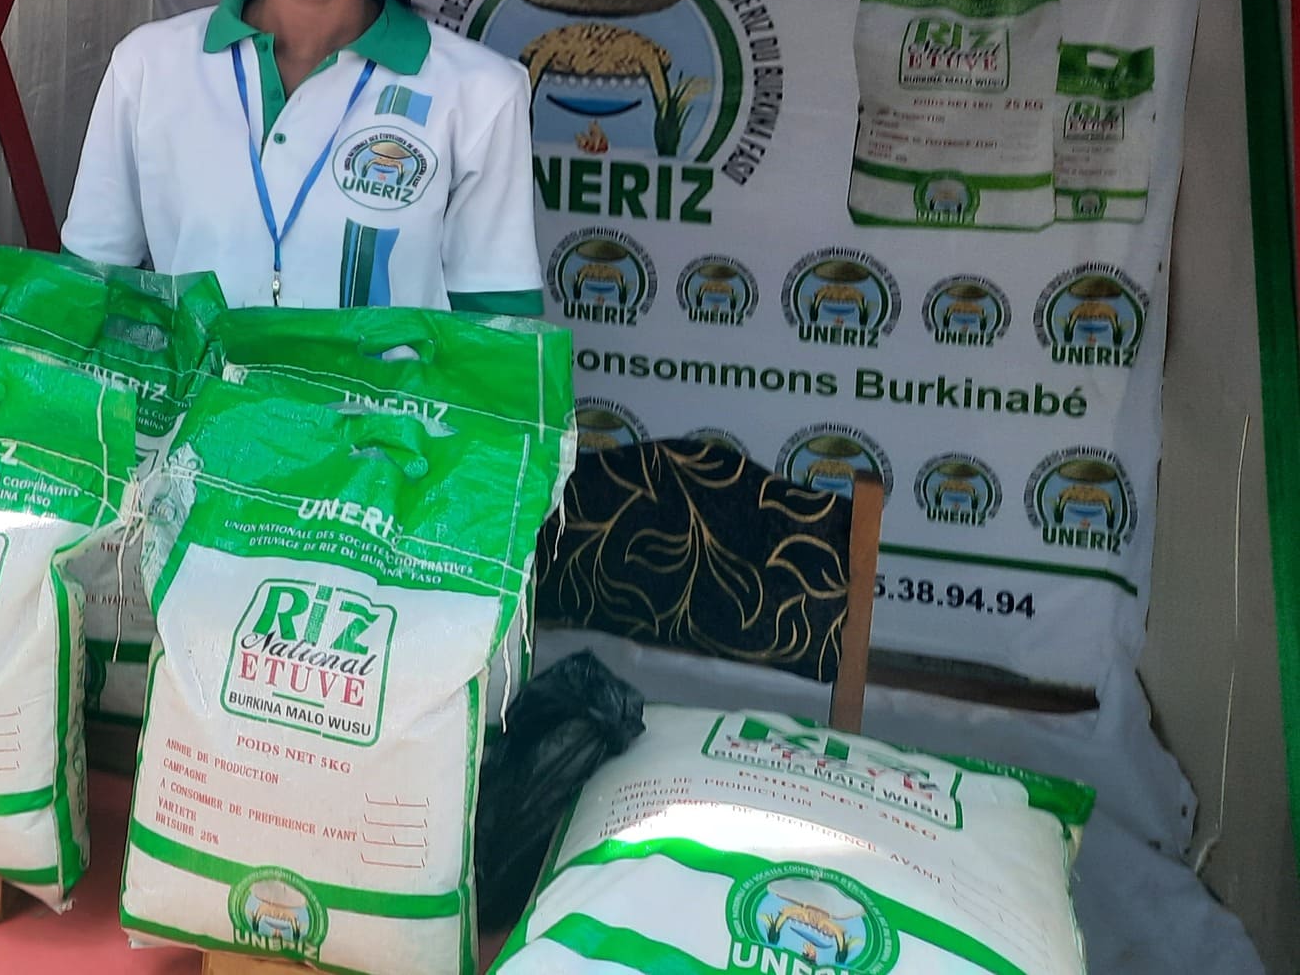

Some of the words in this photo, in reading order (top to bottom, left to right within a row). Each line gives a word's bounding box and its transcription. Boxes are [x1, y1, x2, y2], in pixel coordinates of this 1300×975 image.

[342, 177, 414, 205] UNERIZ
[534, 155, 713, 224] NERIZ
[562, 303, 638, 324] UNERIZ
[688, 309, 744, 325] UNERIZ
[798, 326, 878, 348] UNERIZ
[934, 329, 994, 347] UNERIZ
[1051, 345, 1136, 367] UNERIZ
[573, 349, 838, 397] onsommons
[855, 369, 1088, 418] Burkinabé
[224, 519, 257, 534] UNION
[258, 523, 313, 540] NATIONALE
[316, 530, 335, 541] DES
[926, 508, 986, 527] UNERIZ
[250, 535, 300, 550] D'ÉTUVAGE
[318, 542, 337, 553] RIZ
[340, 546, 357, 559] DU
[1042, 526, 1122, 555] UNERIZ
[251, 584, 380, 655] Riz
[240, 631, 379, 676] National
[238, 653, 366, 707] ETUVE
[229, 691, 282, 715] BURKINA
[286, 705, 324, 726] MALO
[328, 715, 372, 738] WUSU
[197, 751, 209, 763] DE
[214, 758, 279, 784] PRODUCTION
[236, 735, 280, 755] POIDS
[285, 748, 316, 764] NET
[321, 758, 351, 774] 5KG
[163, 758, 207, 783] CAMPAGNE
[171, 782, 223, 810] CONSOMMER
[229, 803, 242, 816] DE
[322, 826, 357, 842] AVANT
